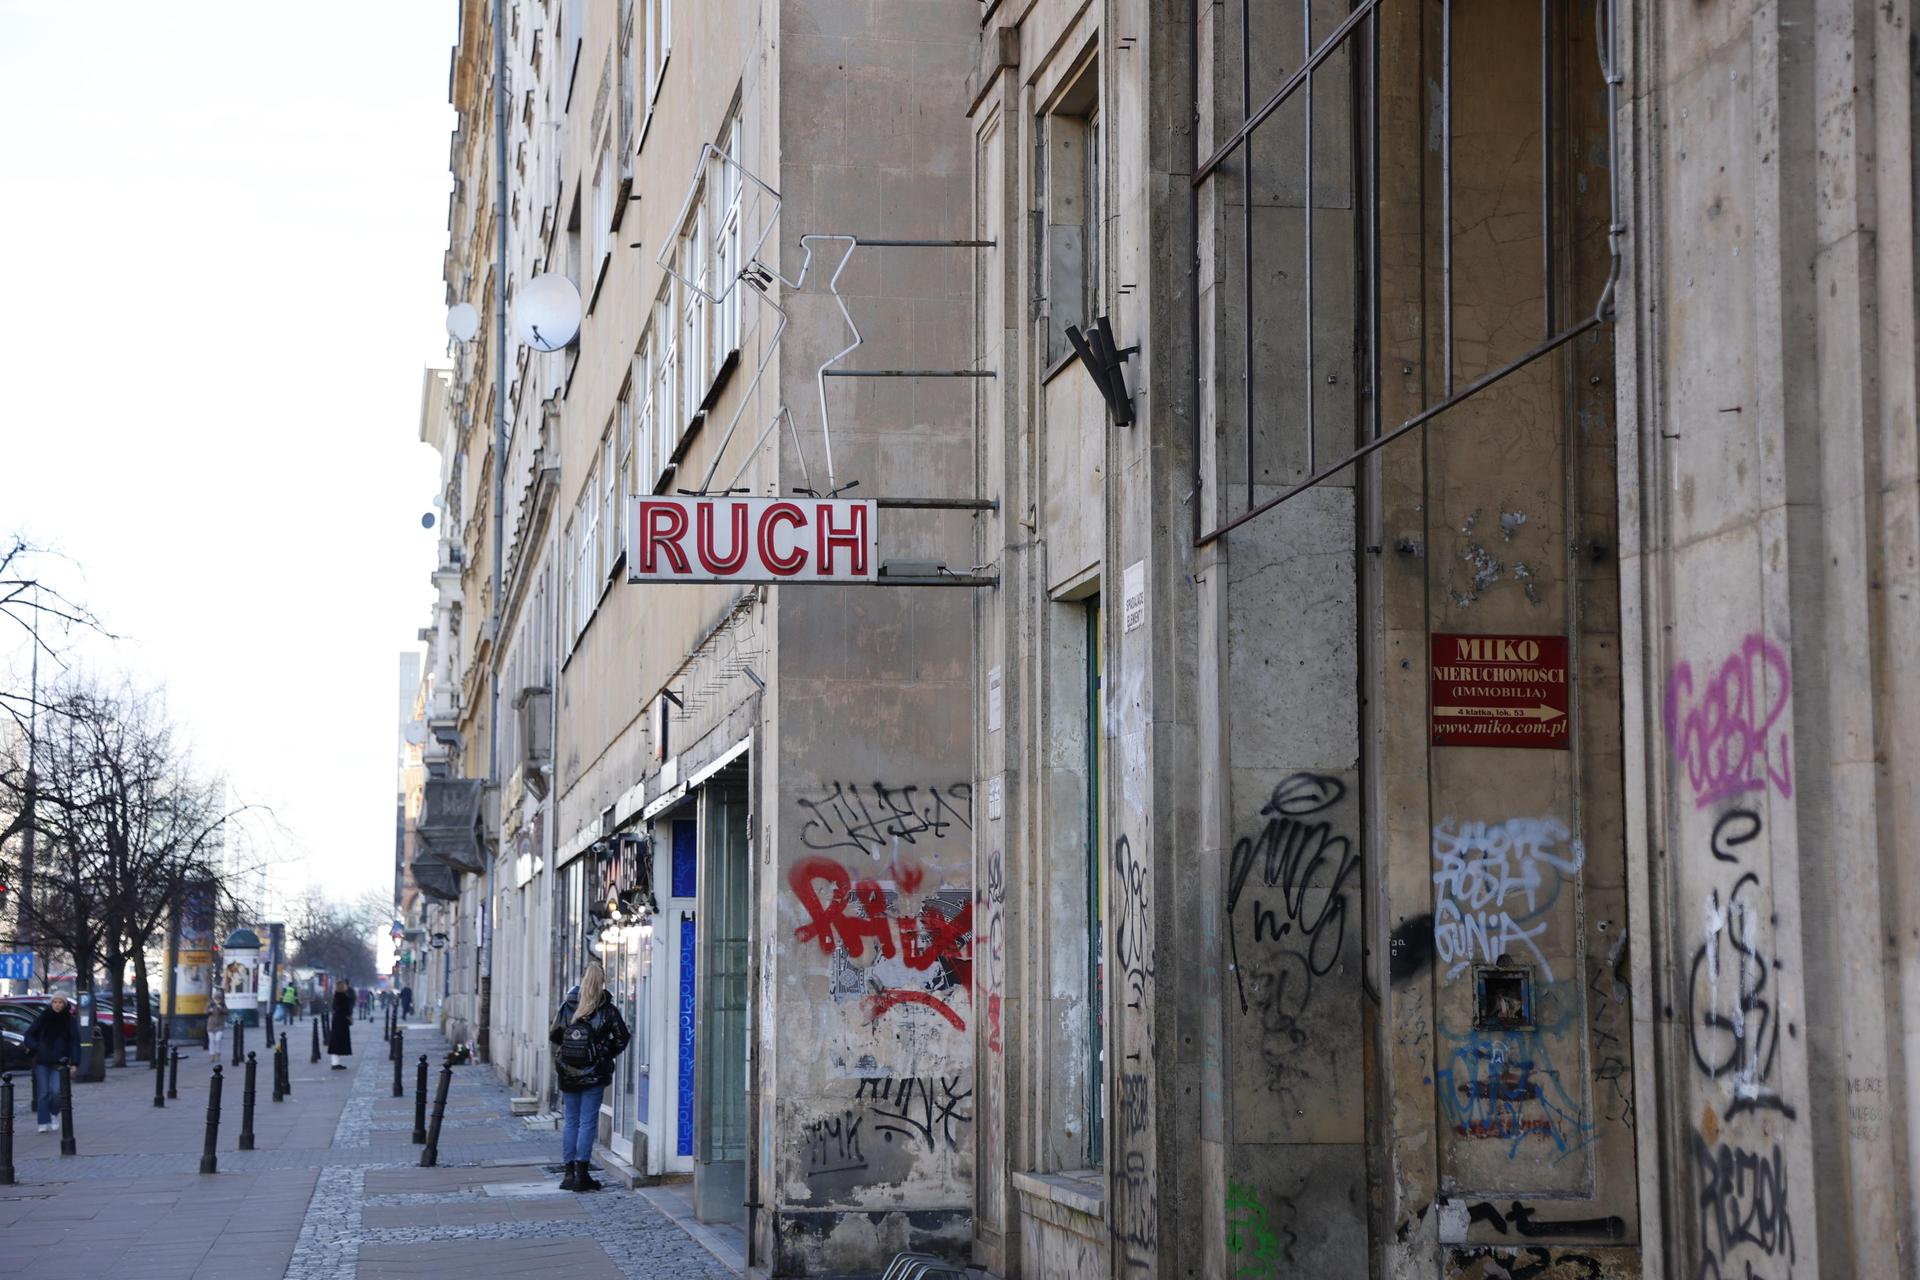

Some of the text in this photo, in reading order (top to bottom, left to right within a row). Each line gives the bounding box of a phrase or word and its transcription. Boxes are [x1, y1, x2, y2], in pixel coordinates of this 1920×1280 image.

[640, 502, 868, 576] RUCH
[1456, 638, 1539, 662] MIKO
[1433, 666, 1565, 683] NIERUCHOMOŚCI
[1452, 686, 1547, 700] (IMMOBILIA)
[1466, 709, 1494, 717] klatka,
[1434, 720, 1567, 737] www.miko.com.pl
